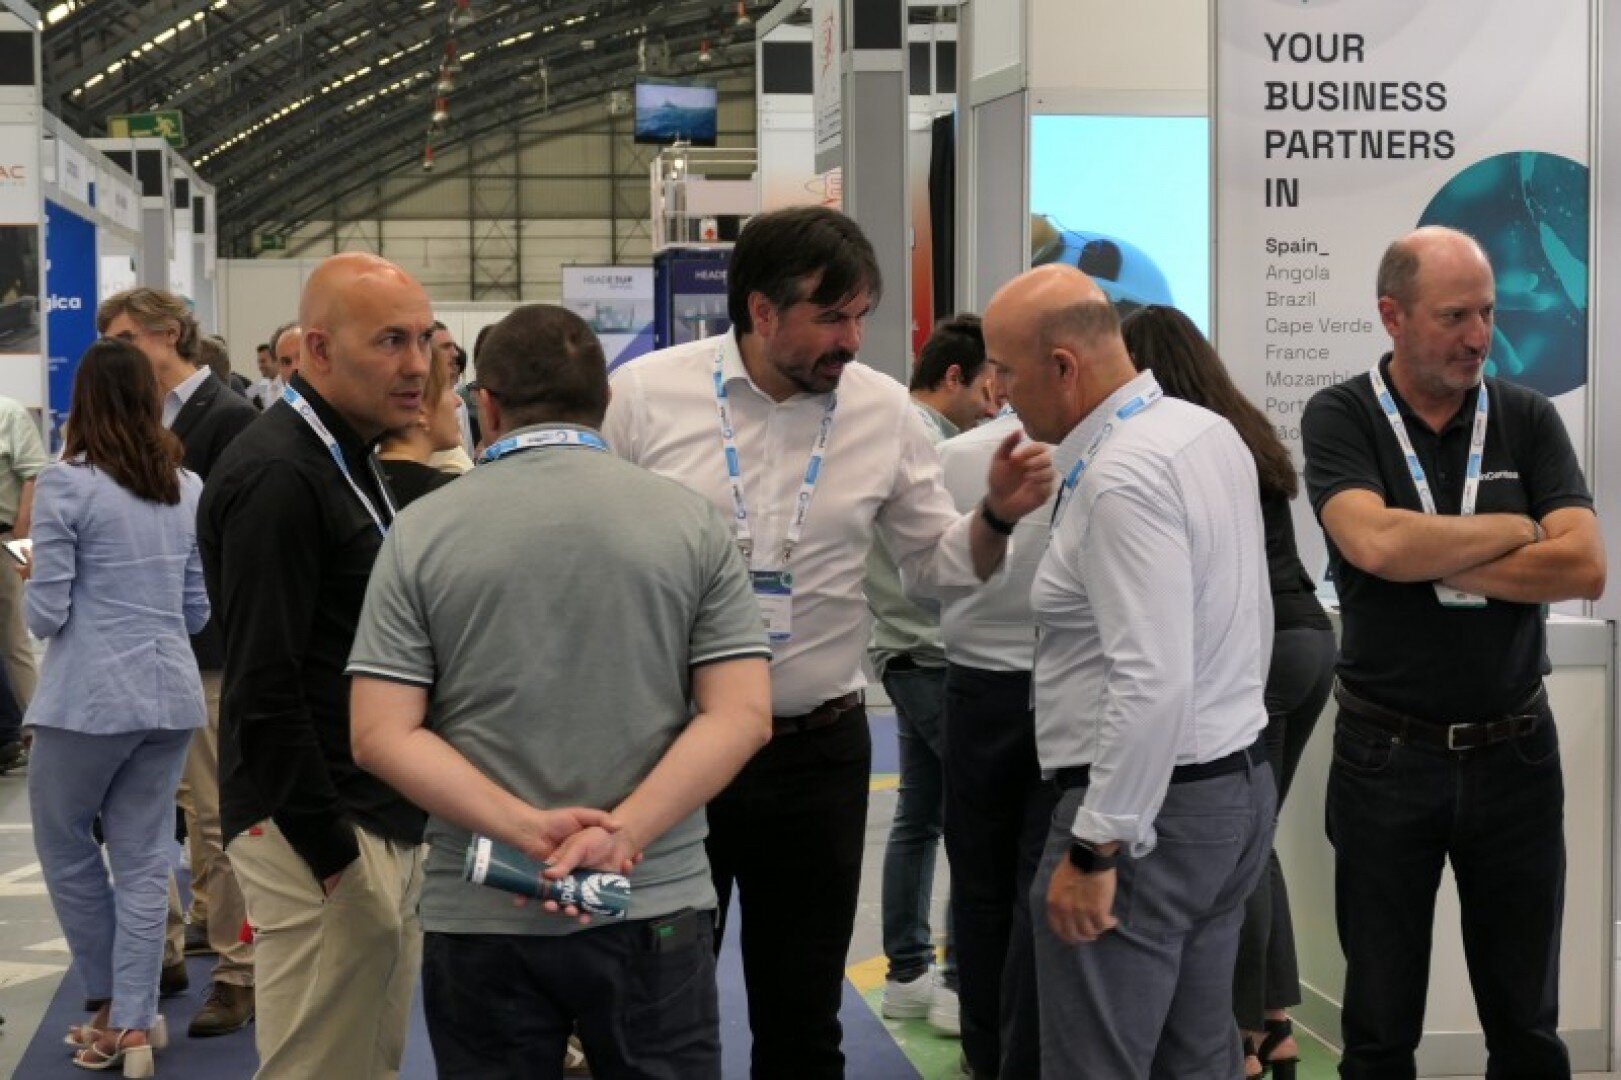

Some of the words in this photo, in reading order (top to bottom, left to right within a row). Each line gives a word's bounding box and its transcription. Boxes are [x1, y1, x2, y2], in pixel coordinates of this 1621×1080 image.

[1264, 32, 1365, 63] YOUR
[1264, 81, 1447, 112] BUSINESS
[1264, 130, 1456, 160] PARTNERS
[1265, 178, 1299, 207] IN
[1265, 264, 1330, 284] Angola
[1266, 291, 1316, 307] Brazil
[1265, 317, 1314, 337] Cape
[1318, 317, 1373, 334] Verde
[1266, 344, 1330, 360] France
[1266, 369, 1350, 387] Mozambi
[1265, 396, 1305, 413] Port
